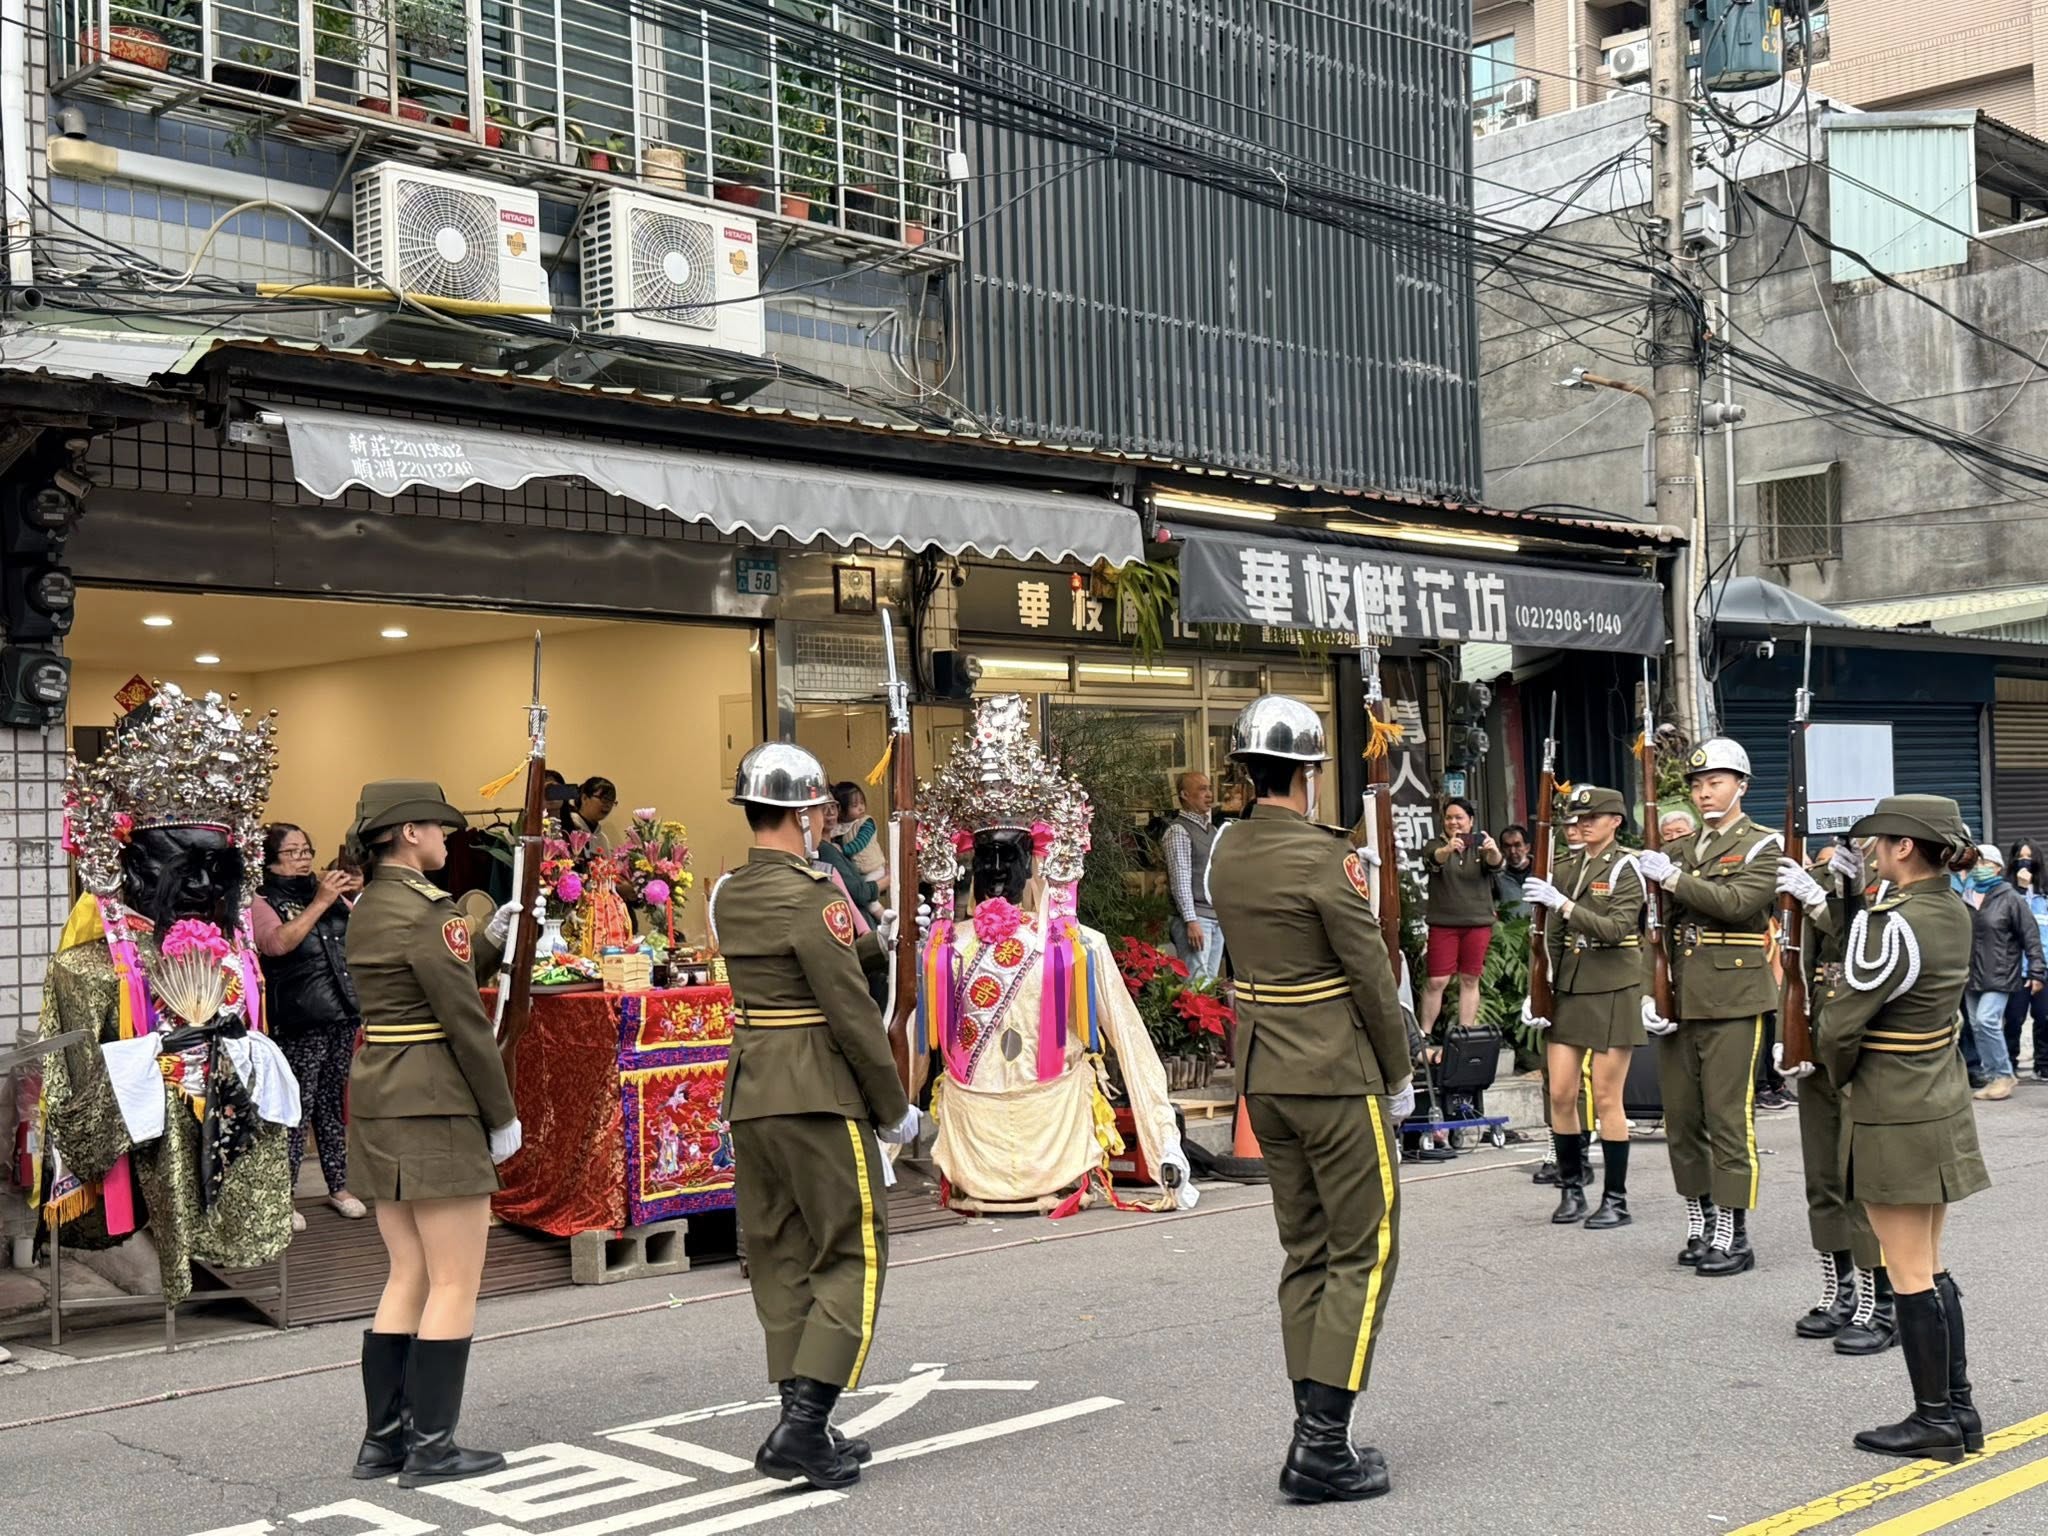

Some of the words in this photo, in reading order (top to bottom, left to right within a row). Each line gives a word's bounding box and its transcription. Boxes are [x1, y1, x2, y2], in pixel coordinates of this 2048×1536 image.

[501, 212, 534, 225] HITACHI
[724, 229, 752, 243] HITACHI
[755, 572, 772, 590] 58
[1239, 547, 1508, 642] 華枝鮮花坊
[1515, 605, 1622, 637] (02)2908-1040
